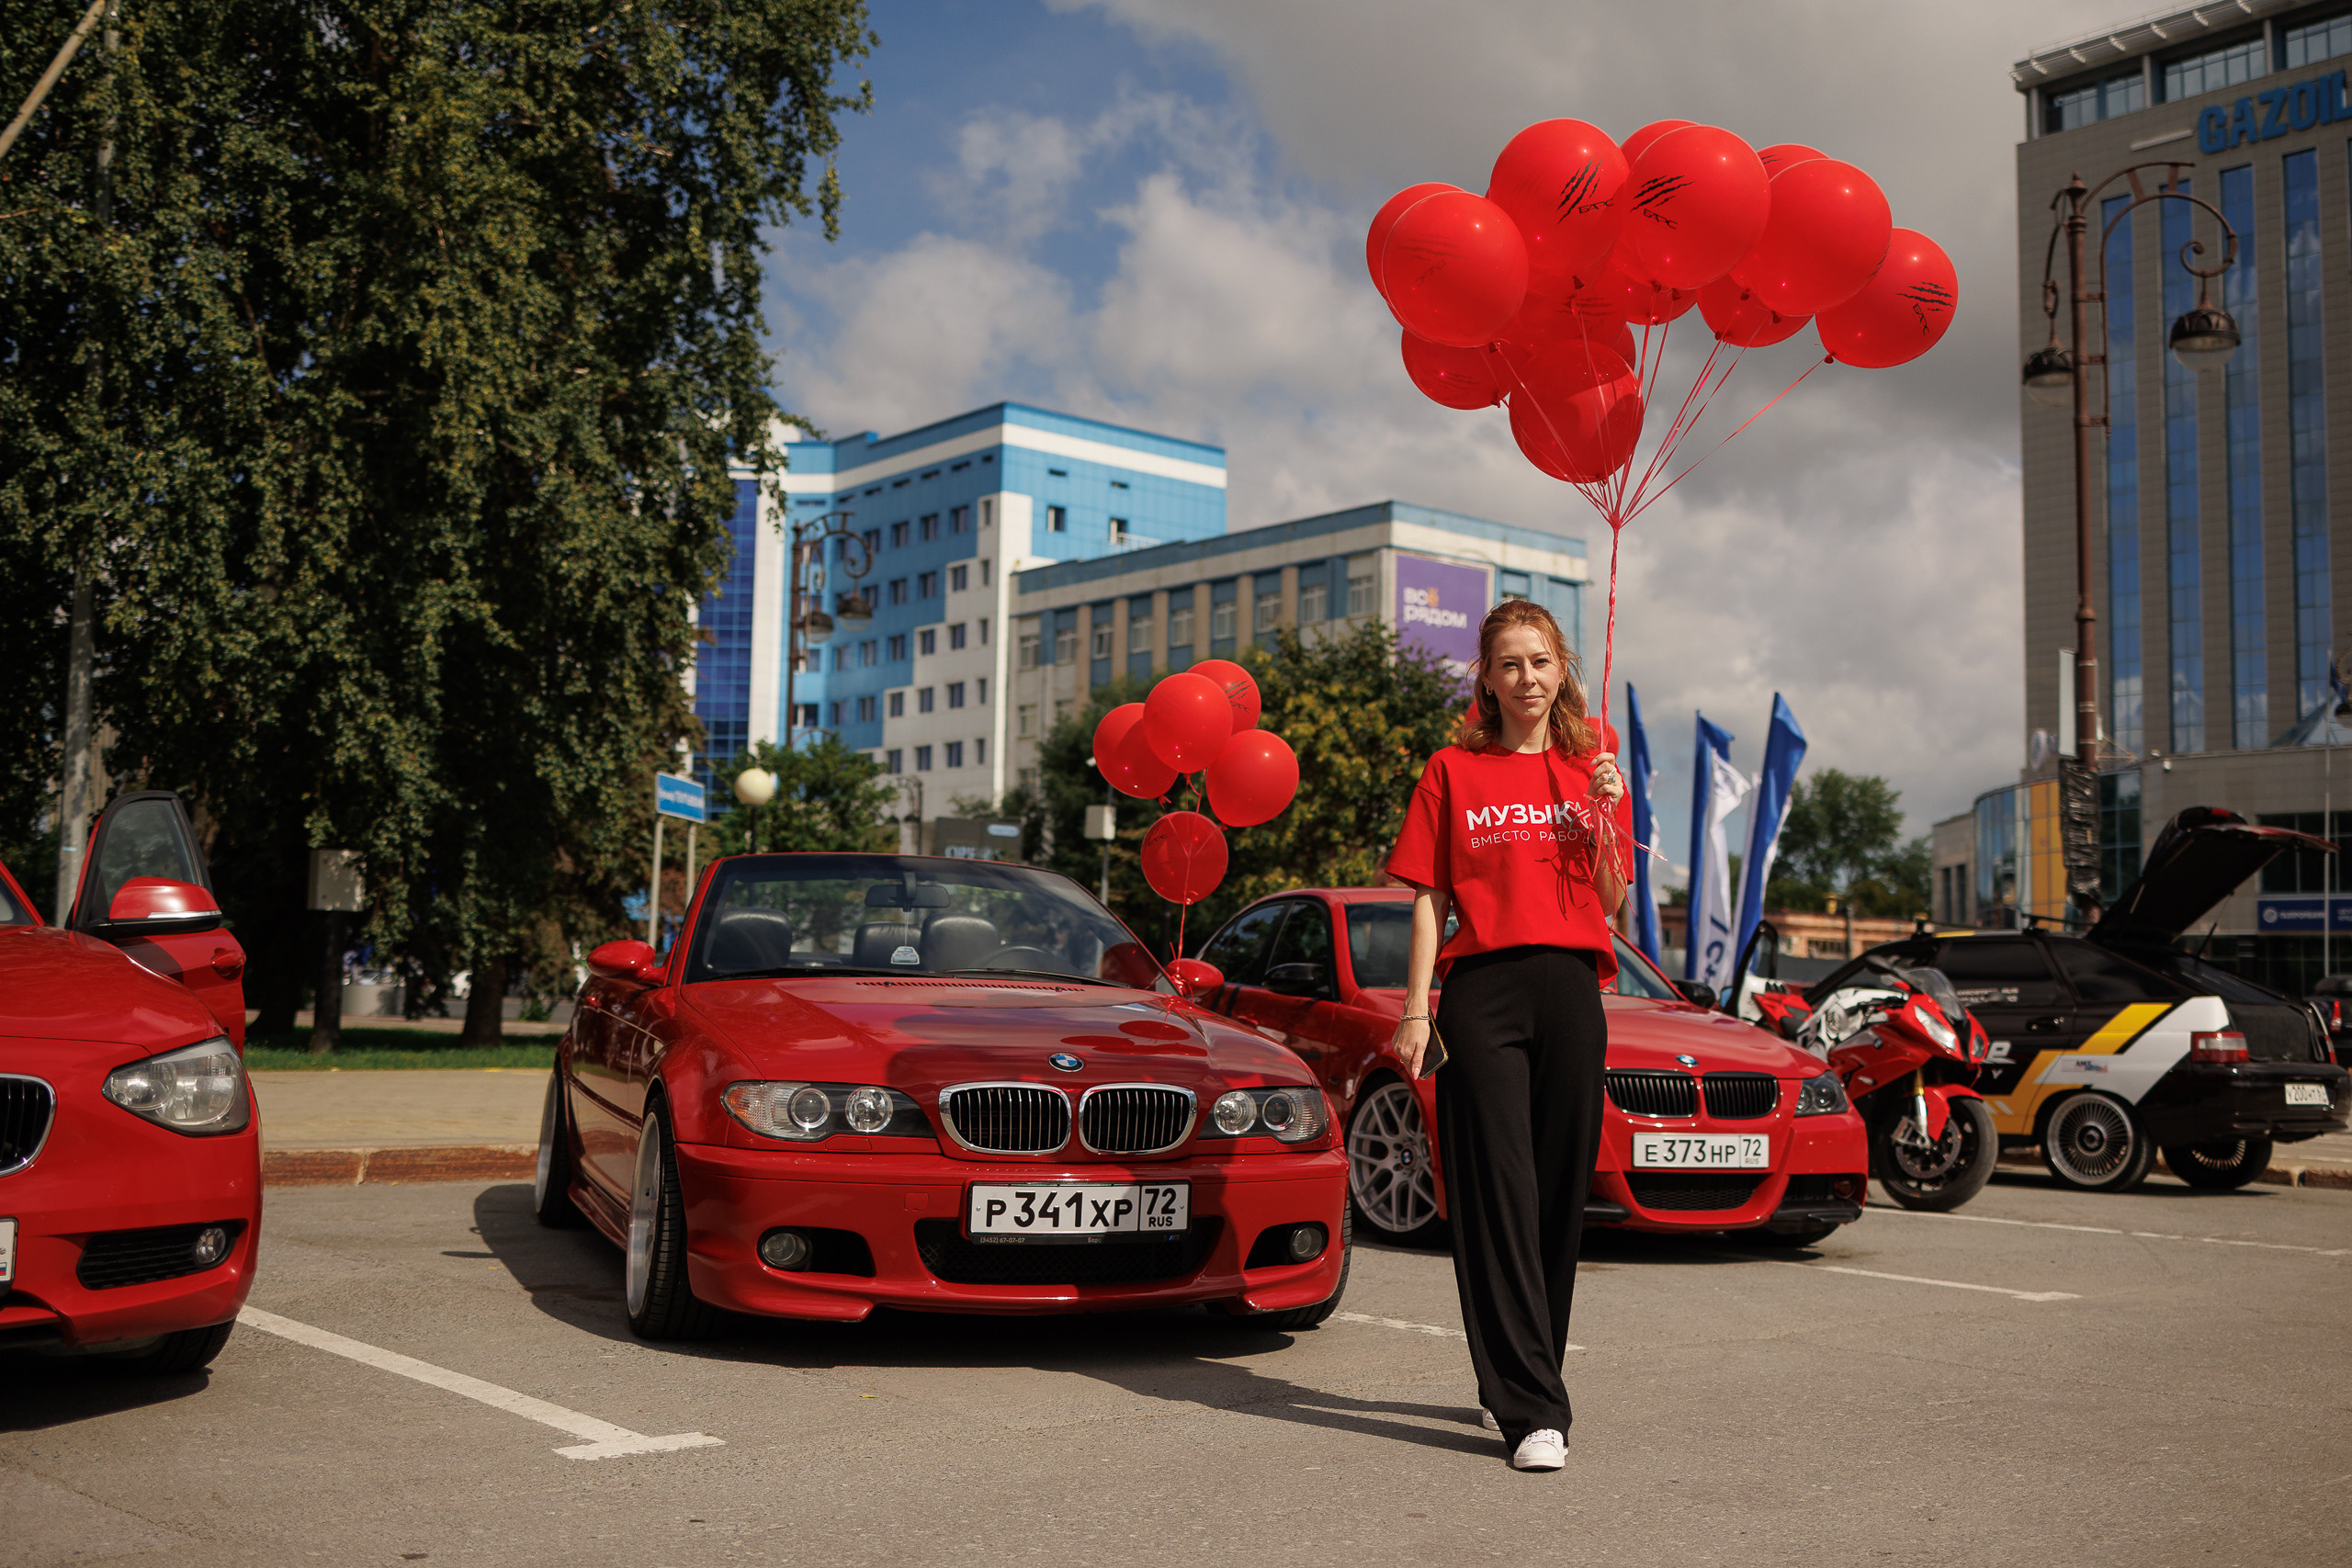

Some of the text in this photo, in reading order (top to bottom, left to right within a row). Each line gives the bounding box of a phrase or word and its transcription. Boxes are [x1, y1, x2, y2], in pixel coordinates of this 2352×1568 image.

[1471, 830, 1532, 849] ВМЕСТО
[1742, 1138, 1762, 1156] 72
[1144, 1188, 1177, 1215] 72
[1148, 1216, 1174, 1228] RUS
